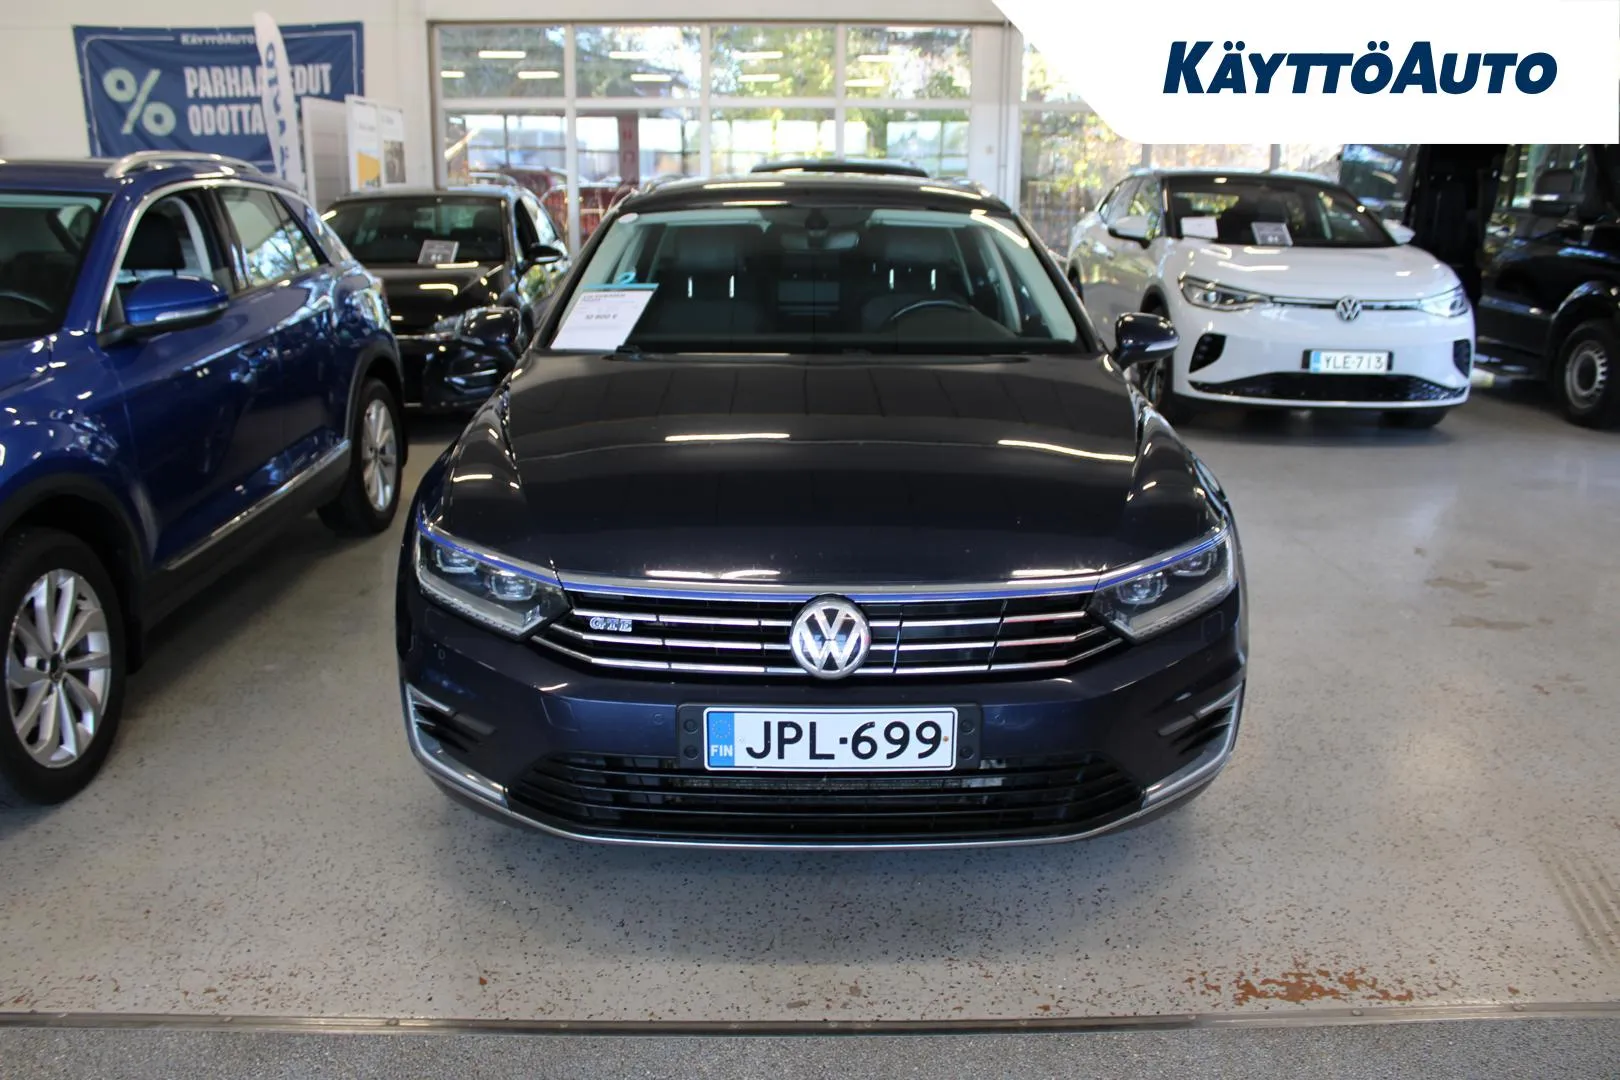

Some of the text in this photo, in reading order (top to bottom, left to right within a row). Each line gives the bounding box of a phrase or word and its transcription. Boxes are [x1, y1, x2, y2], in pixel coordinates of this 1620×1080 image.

[292, 63, 332, 96] DUT
[187, 103, 266, 136] ODOTTA
[710, 744, 734, 758] FIN
[745, 720, 943, 760] JPL-699
